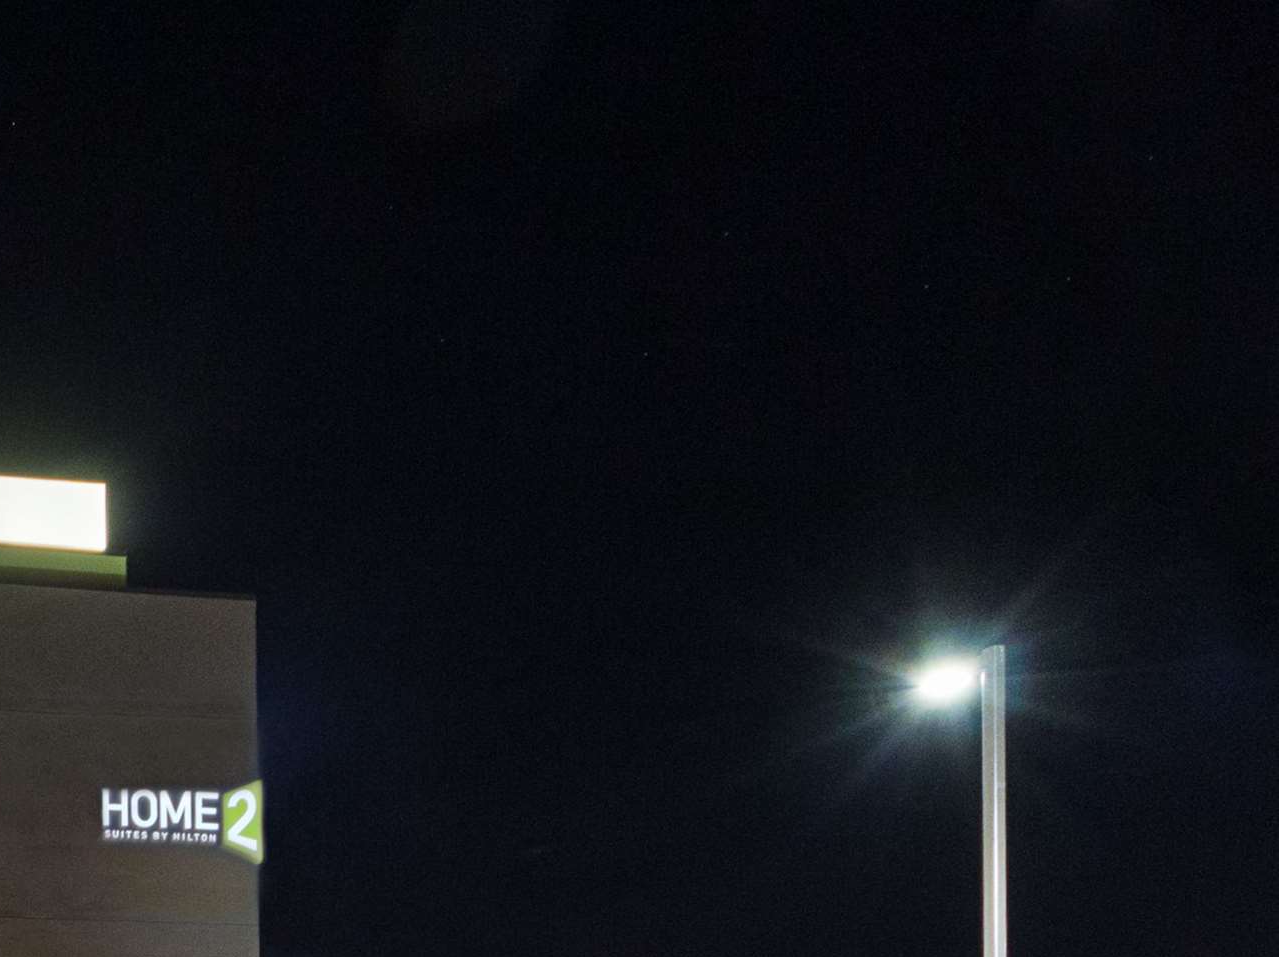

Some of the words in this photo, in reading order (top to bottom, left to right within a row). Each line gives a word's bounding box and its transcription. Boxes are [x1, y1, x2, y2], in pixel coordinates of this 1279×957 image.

[102, 789, 219, 830] HOME
[228, 789, 257, 851] 2
[105, 829, 147, 840] SUITES
[152, 831, 167, 841] BY
[172, 832, 217, 842] HILTON
